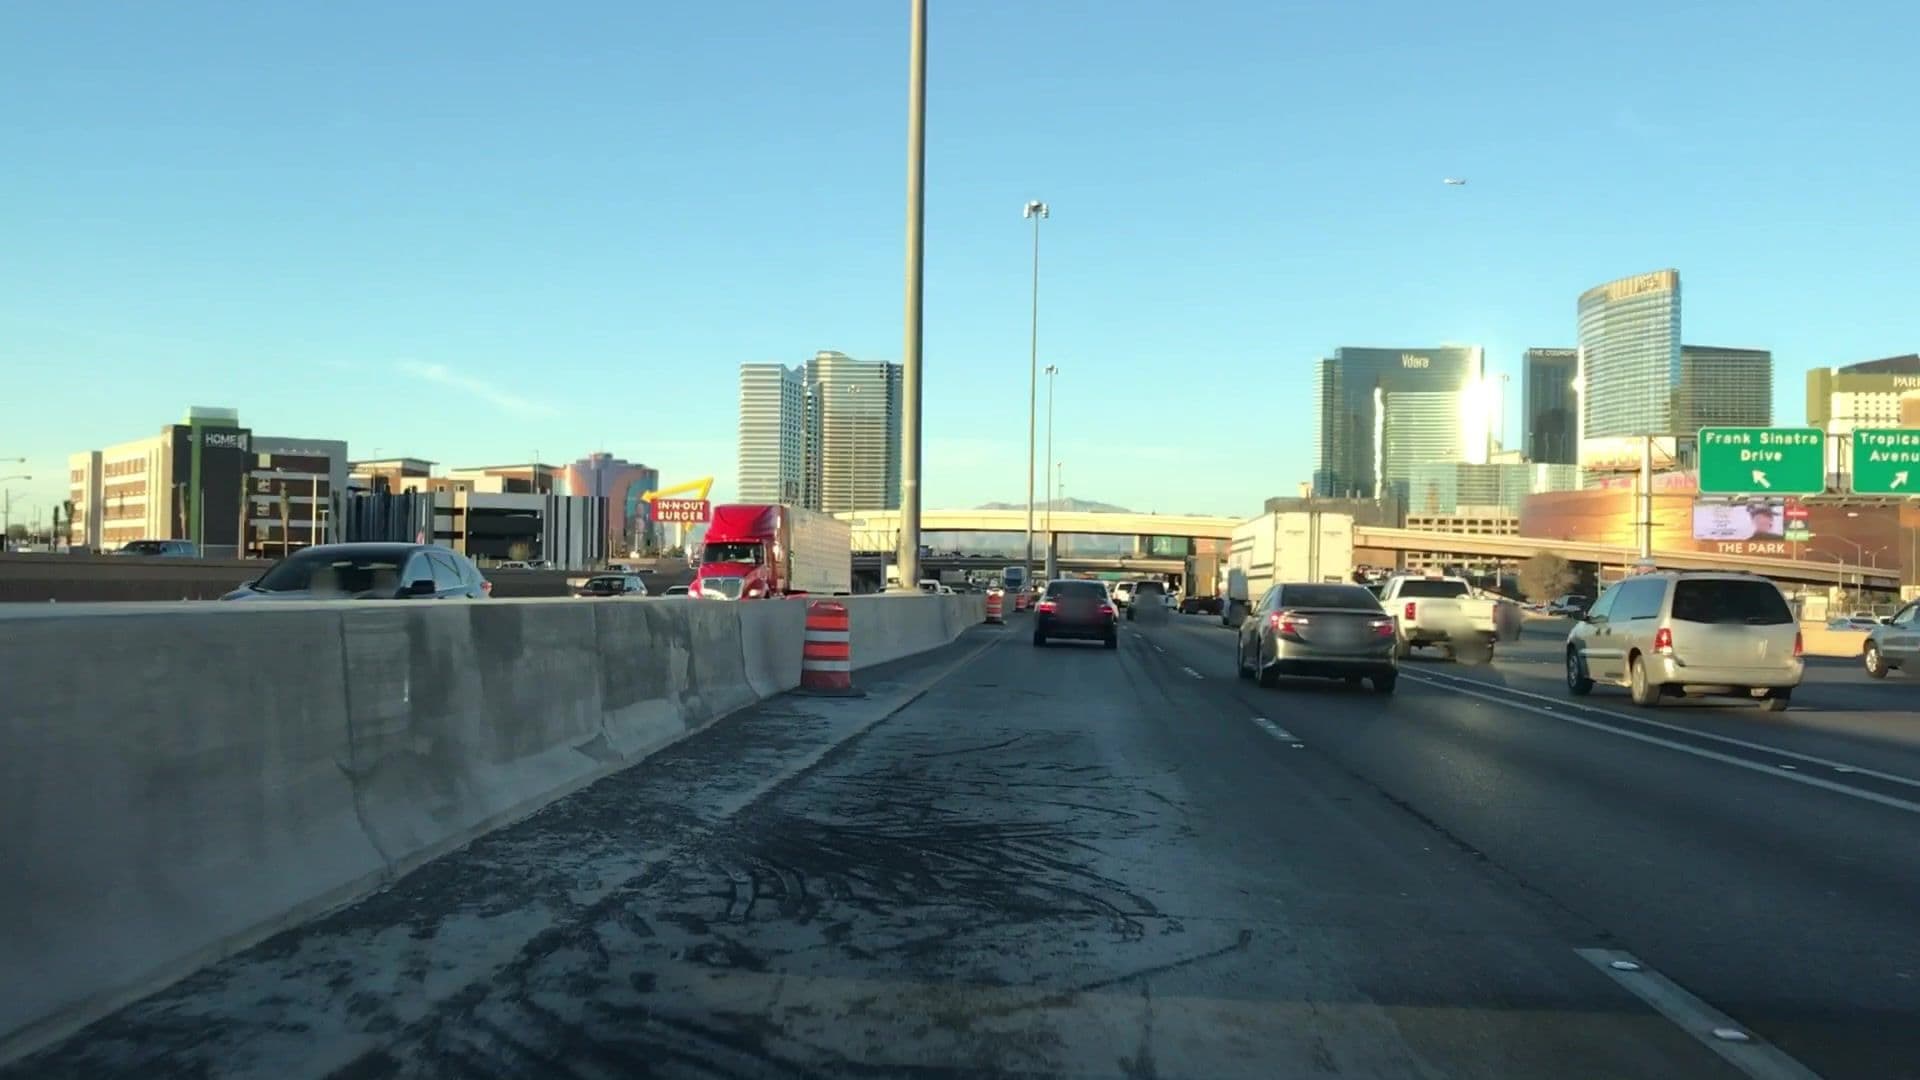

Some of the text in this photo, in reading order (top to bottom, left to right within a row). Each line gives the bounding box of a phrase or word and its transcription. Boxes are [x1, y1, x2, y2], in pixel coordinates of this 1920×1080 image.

[1402, 353, 1429, 368] Vdara
[206, 433, 236, 444] HOME
[1706, 432, 1818, 444] Frank Sinatra
[1860, 433, 1920, 447] Tropica
[1741, 449, 1783, 461] Drive
[1869, 449, 1920, 462] Avenu
[658, 511, 703, 520] BURGER
[1717, 542, 1784, 553] THE PARK
